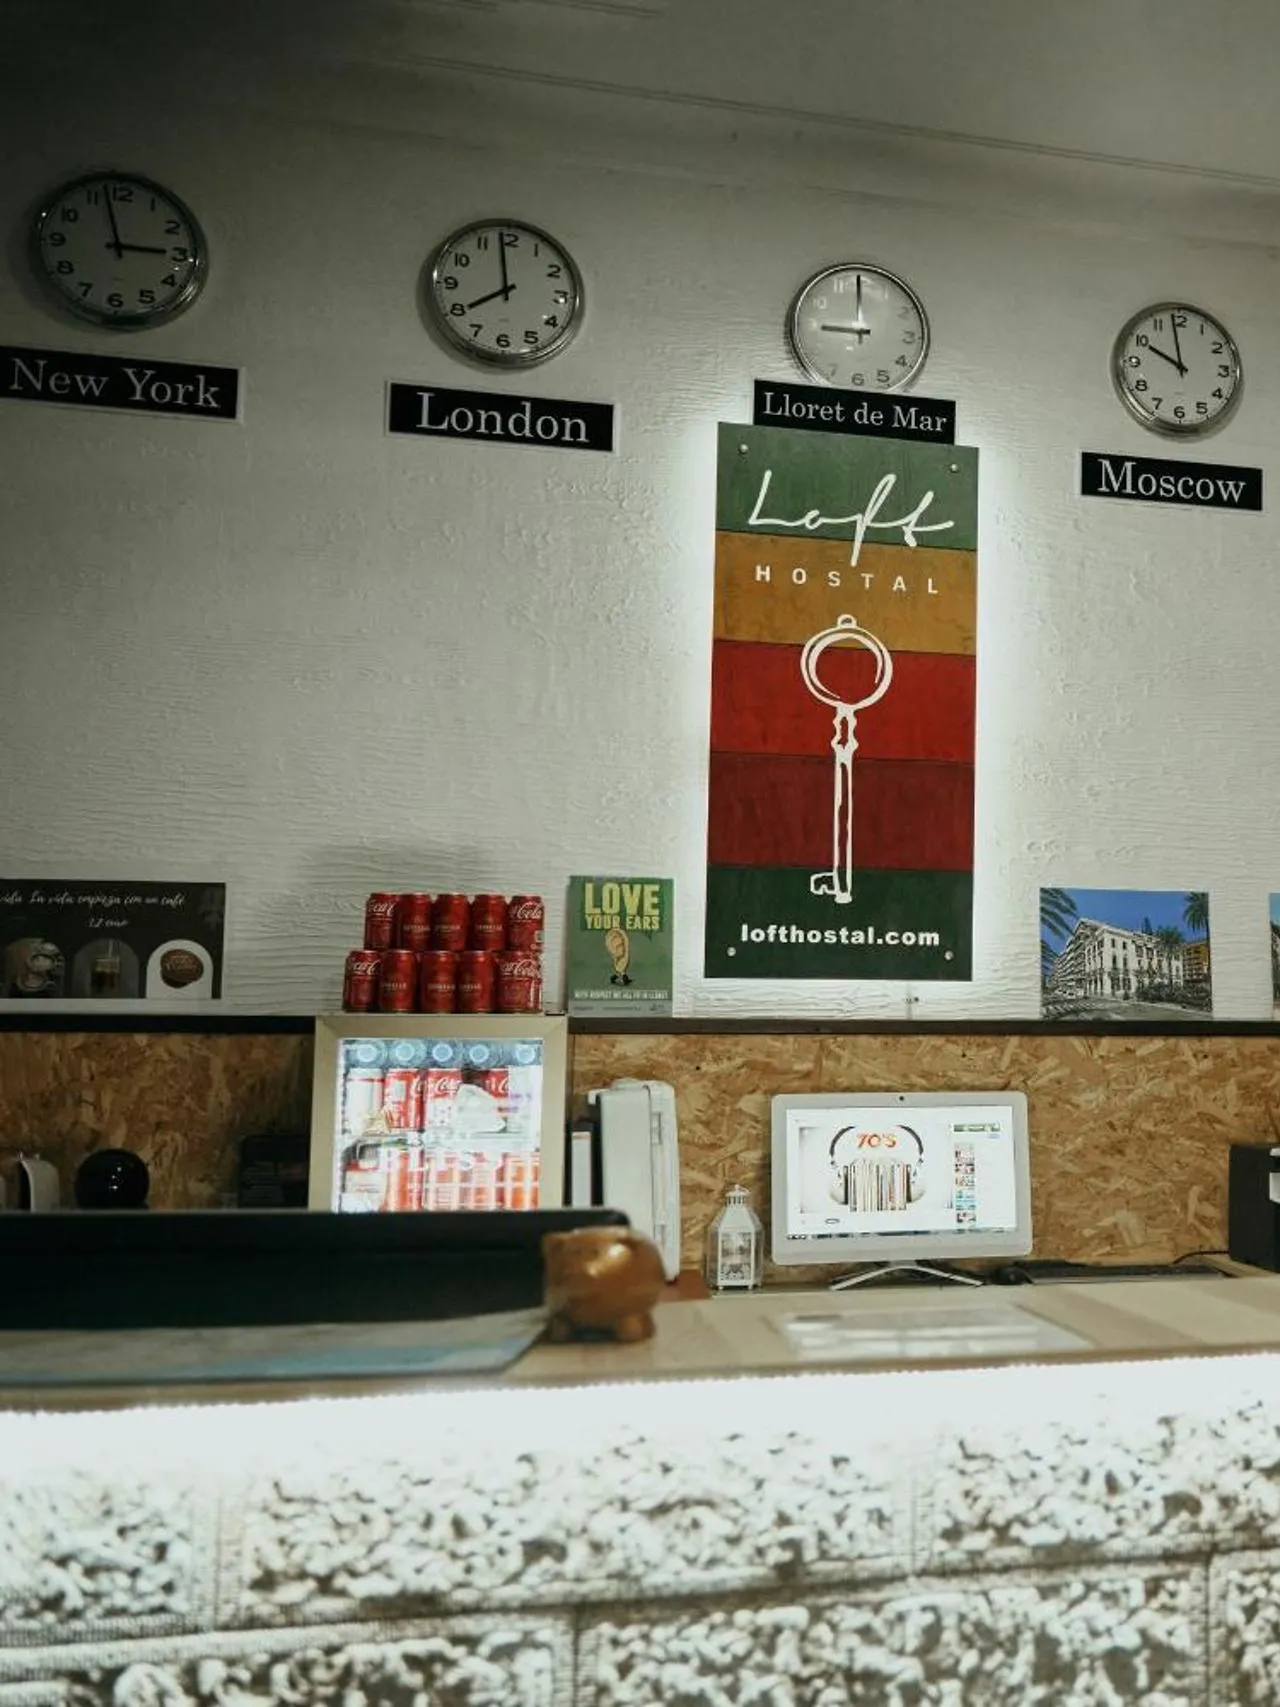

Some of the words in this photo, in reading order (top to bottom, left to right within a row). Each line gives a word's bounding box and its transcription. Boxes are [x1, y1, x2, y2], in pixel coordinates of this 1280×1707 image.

[87, 190, 98, 205] 11
[113, 187, 134, 202] 12
[62, 206, 78, 222] 10
[165, 221, 181, 234] 2
[50, 233, 66, 246] 9
[478, 237, 488, 250] 11
[172, 247, 188, 262] 3
[455, 253, 470, 267] 10
[57, 261, 74, 274] 8
[547, 264, 561, 278] 2
[161, 274, 176, 287] 4
[444, 277, 458, 290] 9
[77, 283, 93, 296] 7
[107, 293, 123, 307] 6
[139, 290, 156, 304] 5
[451, 303, 466, 317] 8
[544, 315, 558, 328] 4
[1153, 318, 1163, 331] 11
[470, 324, 483, 337] 7
[524, 330, 538, 344] 5
[496, 334, 510, 348] 6
[902, 331, 916, 344] 3
[1136, 334, 1149, 347] 10
[1211, 342, 1223, 354] 2
[895, 355, 907, 367] 4
[1128, 356, 1140, 368] 9
[876, 369, 890, 383] 5
[1218, 365, 1230, 378] 3
[9, 358, 109, 397] New
[123, 368, 221, 408] York
[852, 373, 864, 386] 6
[1135, 380, 1148, 391] 8
[1211, 388, 1223, 400] 4
[1152, 398, 1163, 410] 7
[1196, 402, 1208, 415] 5
[416, 391, 590, 443] London
[763, 392, 845, 422] Lloret
[854, 400, 884, 425] de
[892, 405, 948, 431] Mar
[1173, 406, 1185, 418] 6
[1097, 459, 1246, 503] Moscow
[748, 469, 954, 567] Loft
[755, 565, 938, 594] HOSTAL
[584, 882, 660, 915] LOVE
[585, 914, 620, 930] YOUR
[626, 915, 660, 930] EARS
[741, 924, 940, 946] lofthostal.com
